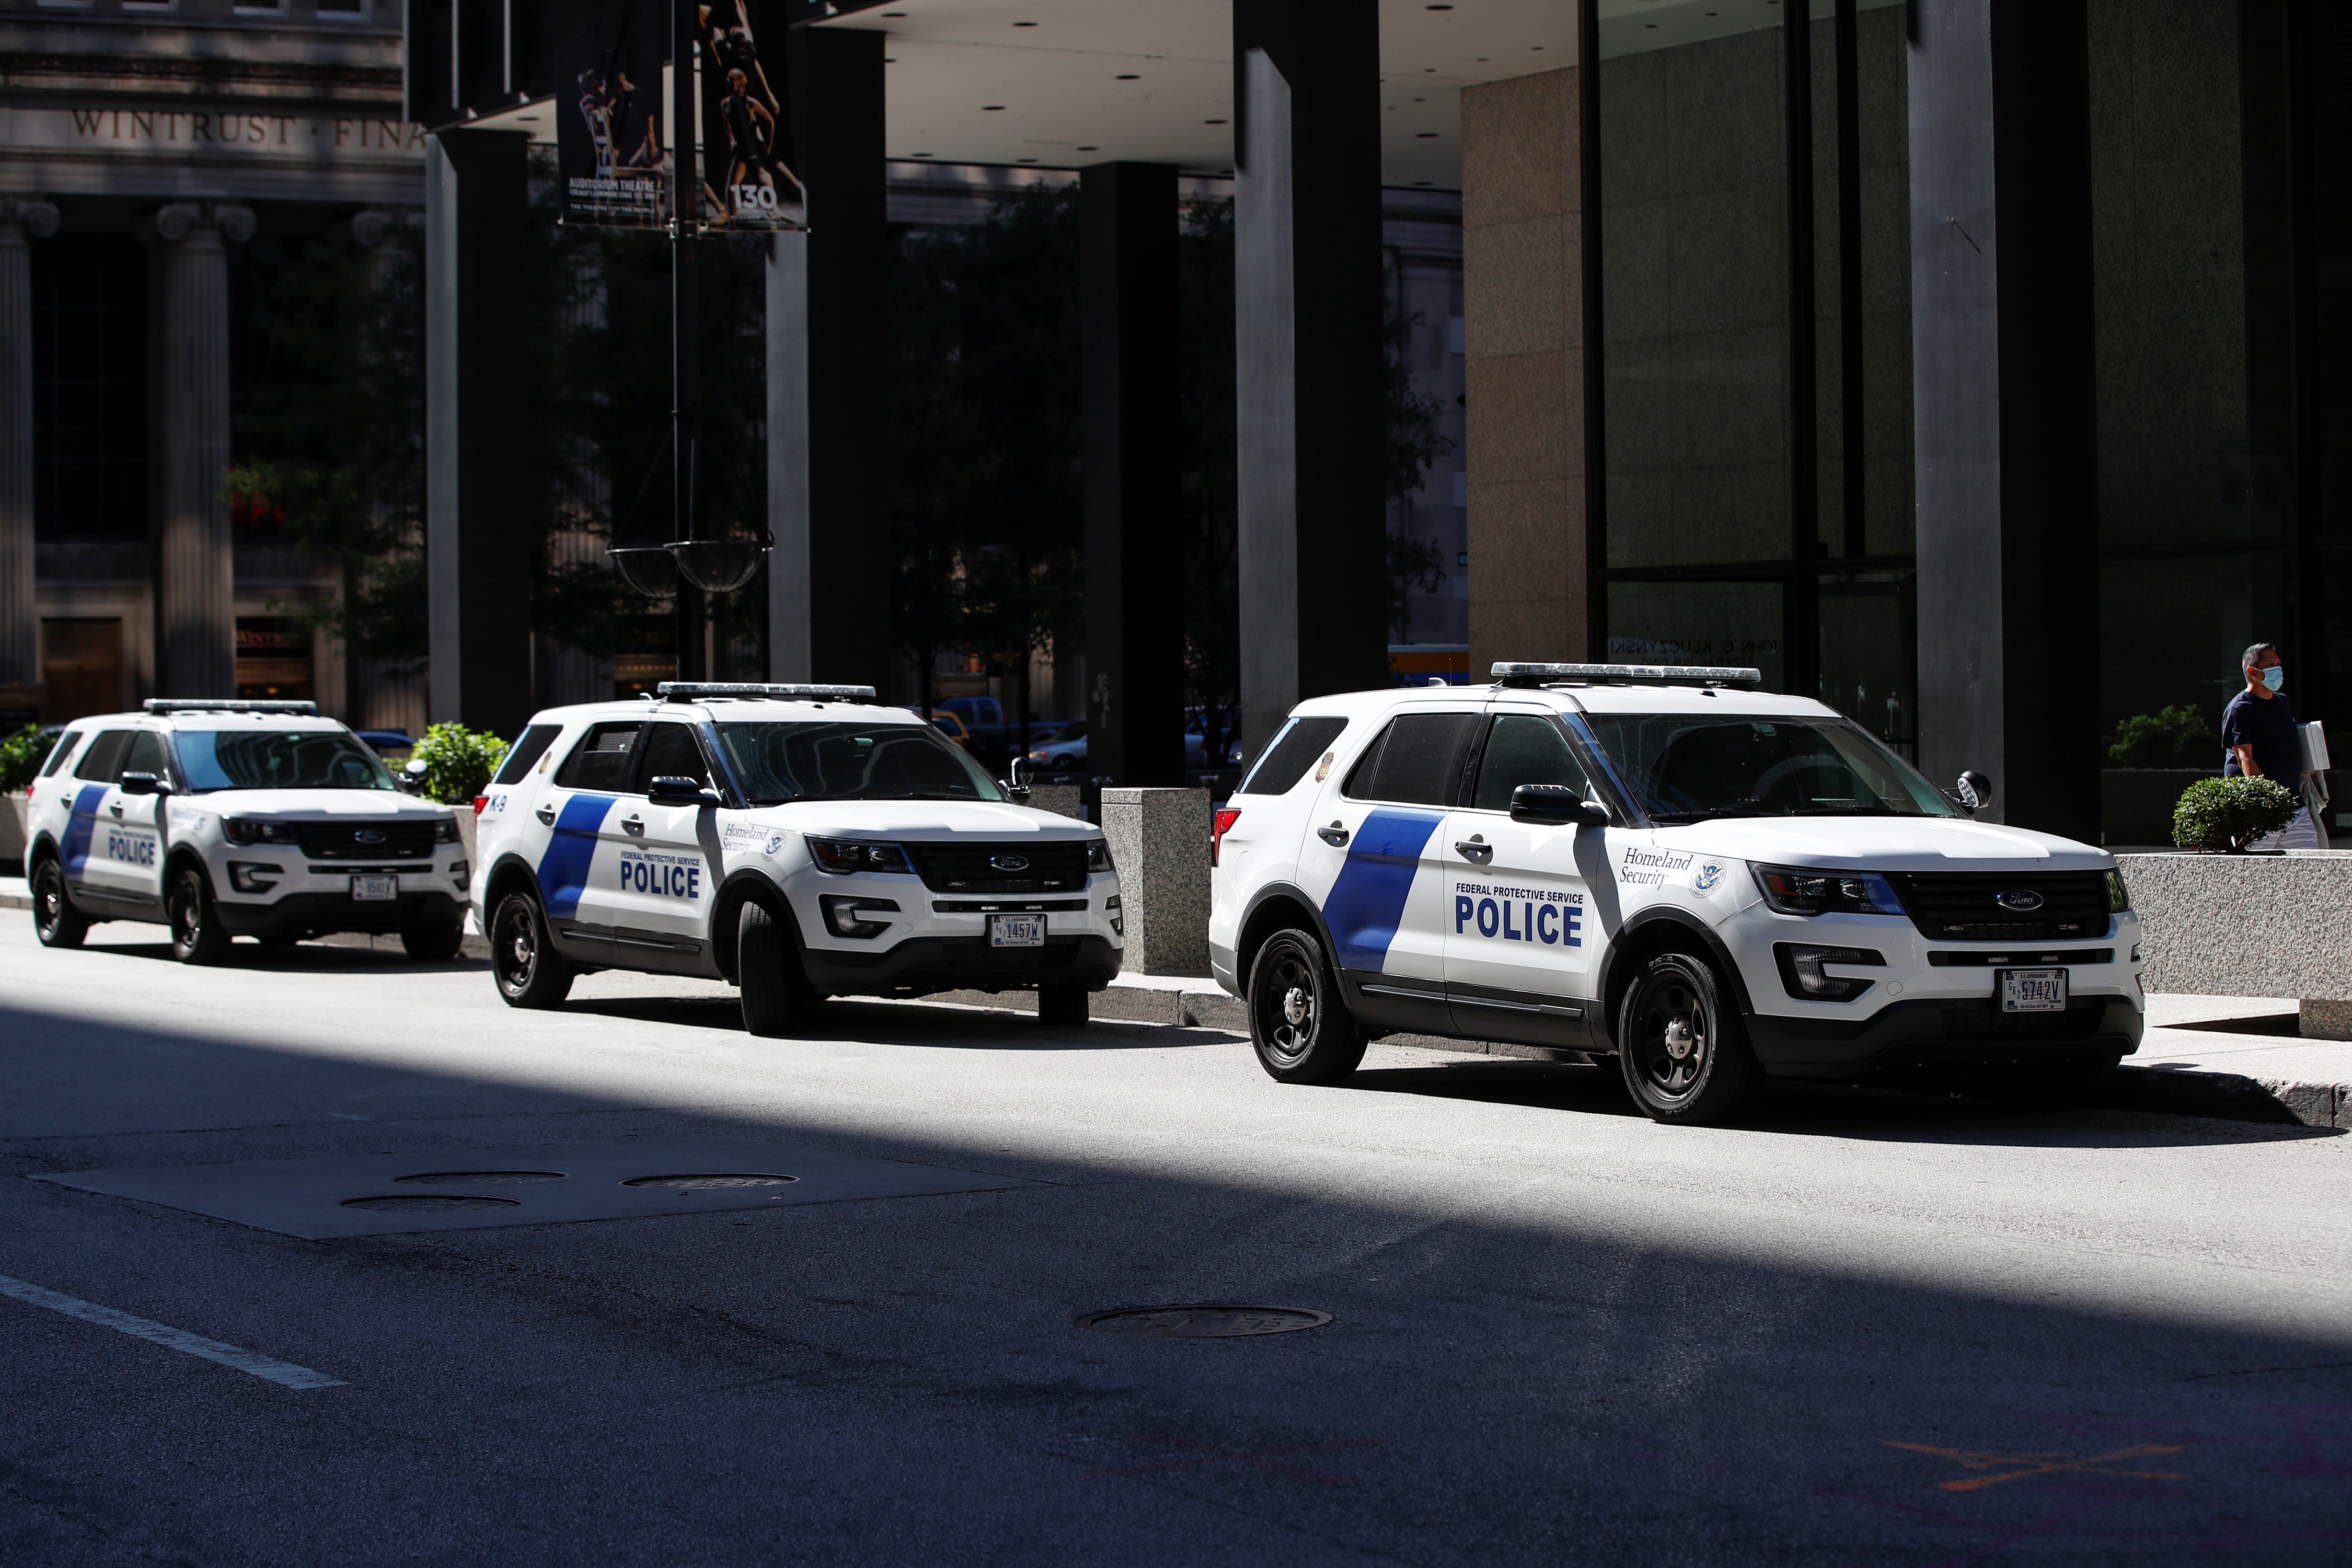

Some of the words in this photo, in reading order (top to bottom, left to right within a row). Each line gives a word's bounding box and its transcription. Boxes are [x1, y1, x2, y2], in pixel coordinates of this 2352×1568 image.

[72, 110, 296, 144] WINTRUST
[569, 177, 618, 191] AUDITORIUM
[619, 179, 655, 192] THEATRE
[729, 185, 778, 210] 130
[489, 794, 507, 812] K-9
[724, 823, 769, 840] Homeland
[109, 836, 155, 865] POLICE
[721, 837, 752, 856] Security
[620, 851, 643, 860] FEDERAL
[644, 854, 676, 864] PROTECTIVE
[677, 857, 700, 866] SERVICE
[1000, 857, 1021, 866] Ford
[1623, 847, 1693, 870] Homeland
[620, 860, 699, 898] POLICE
[1620, 866, 1669, 891] Security
[1456, 882, 1491, 895] FEDERAL
[1493, 886, 1545, 901] PROTECTIVE
[1547, 891, 1583, 904] SERVICE
[2010, 892, 2035, 904] Ford
[1007, 923, 1038, 938] 1457W
[1456, 895, 1583, 948] POLICE
[2022, 980, 2059, 1000] 5742V
